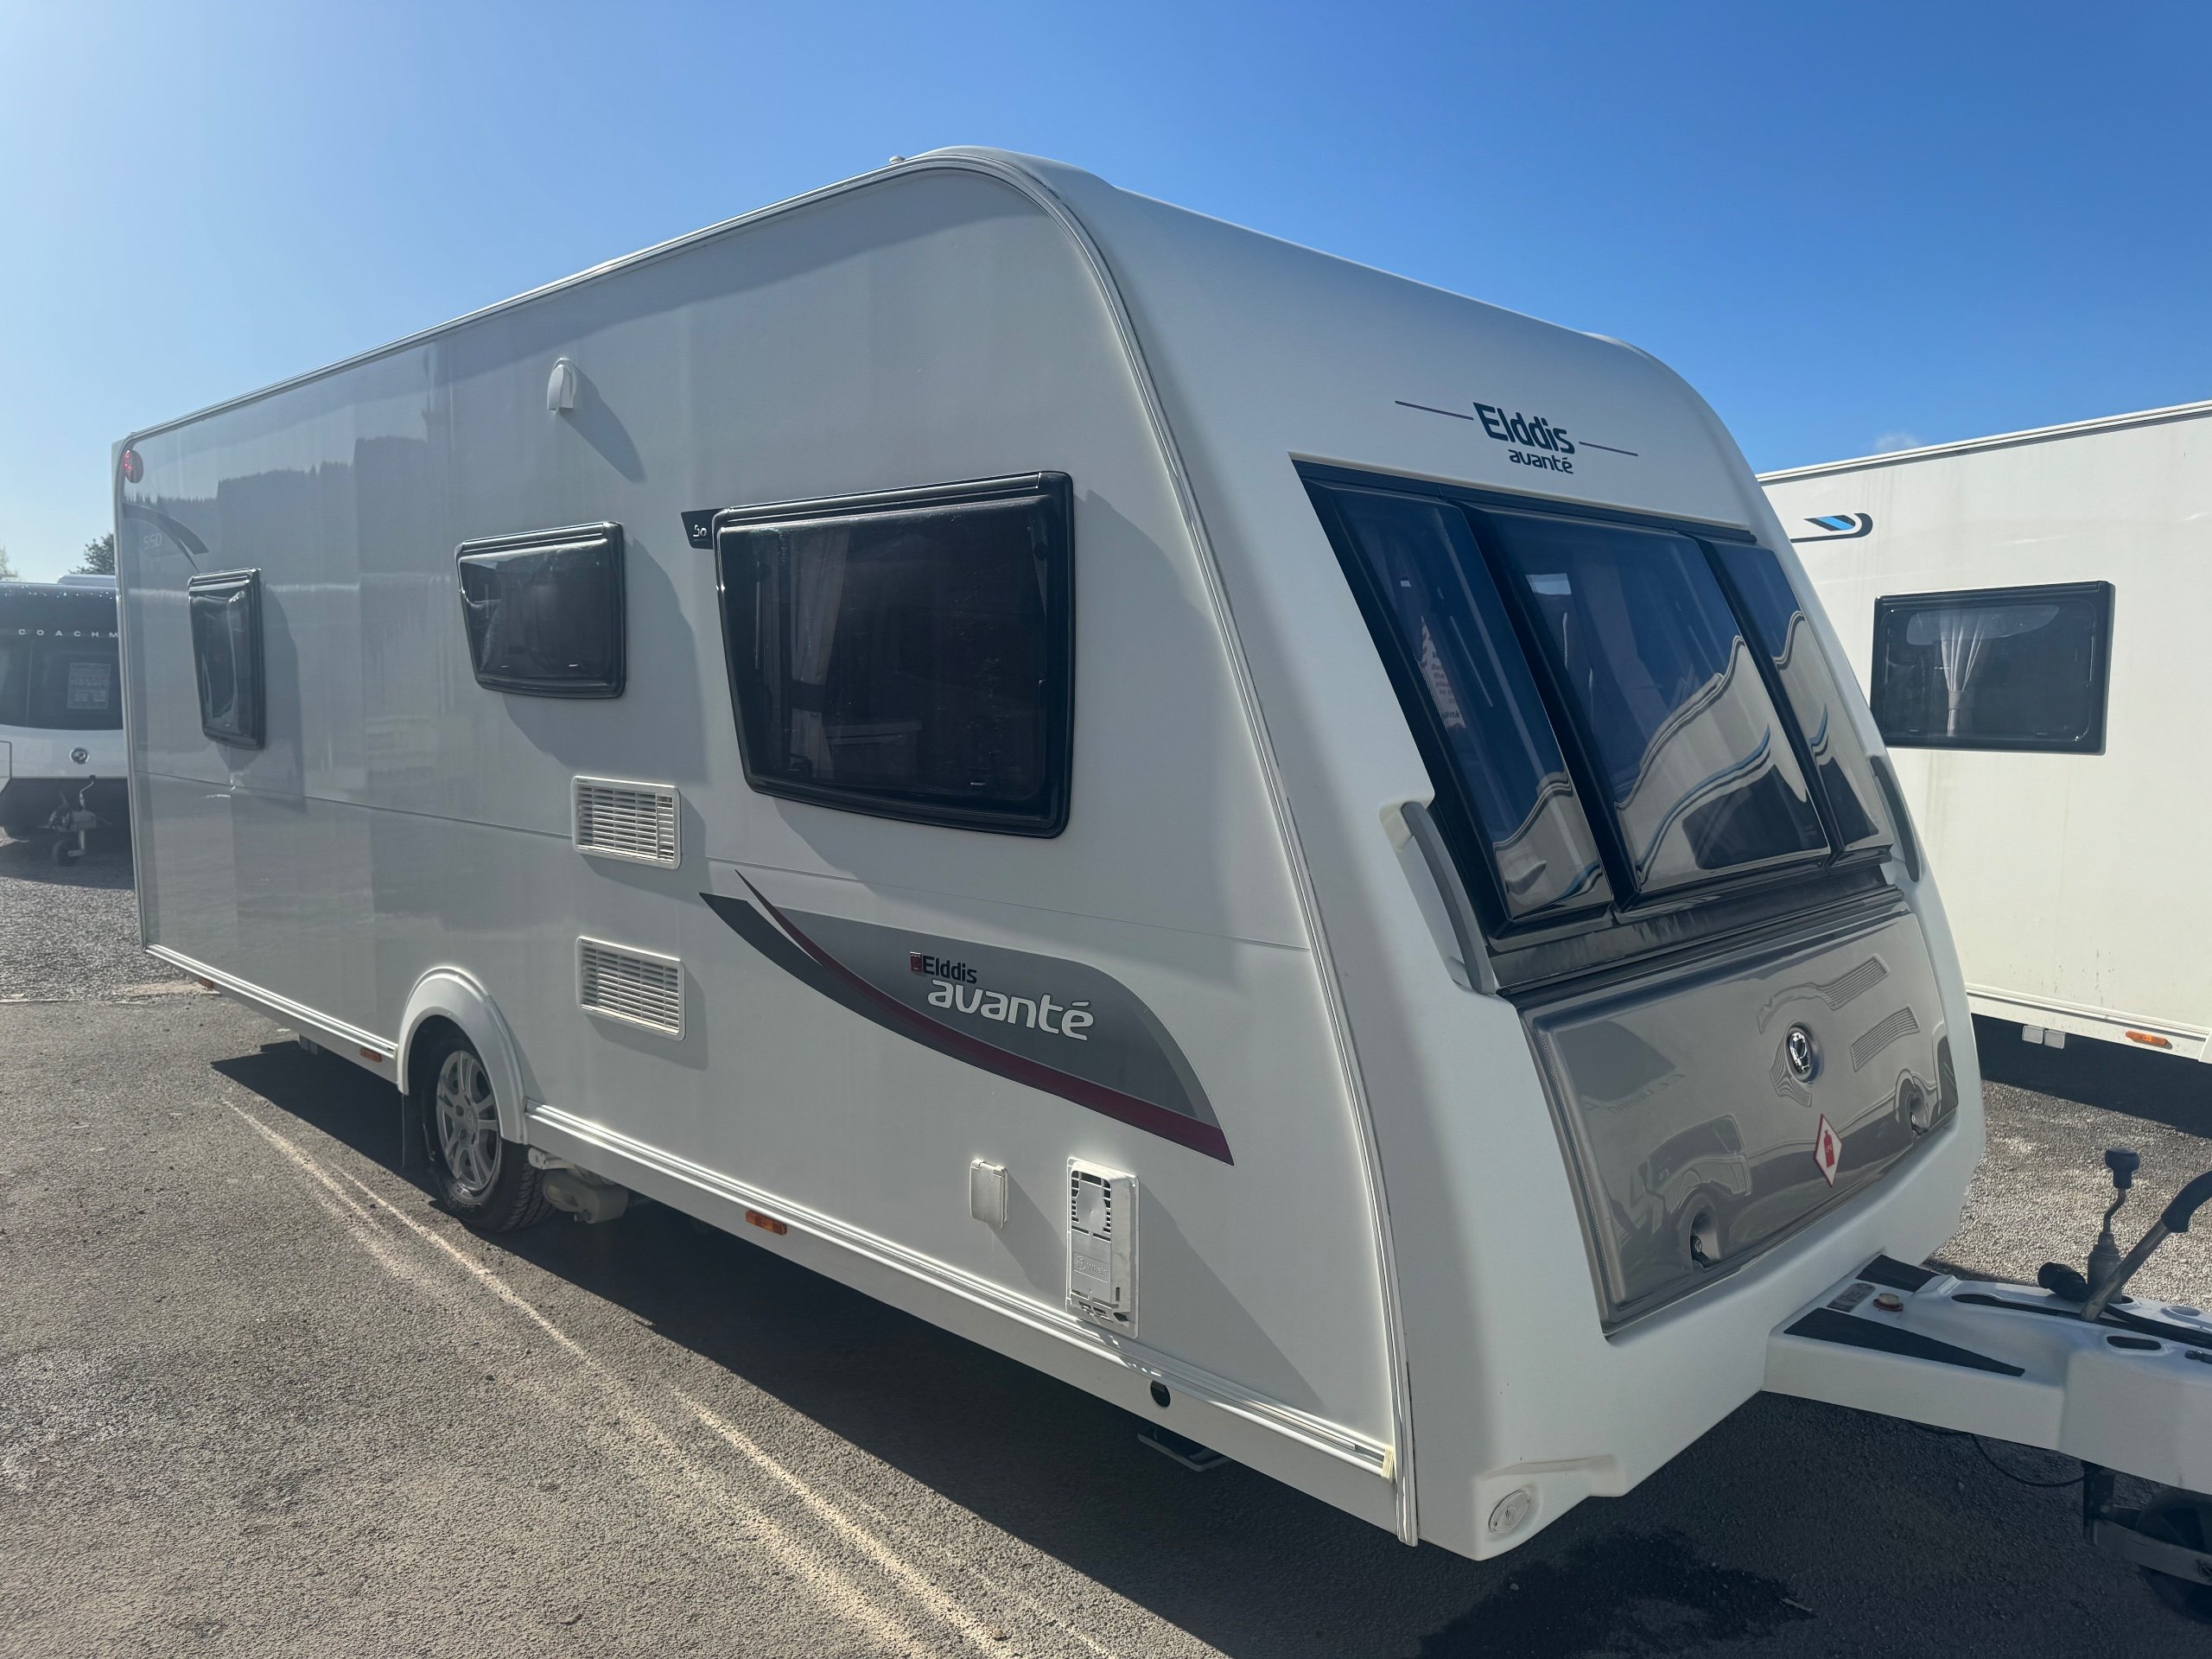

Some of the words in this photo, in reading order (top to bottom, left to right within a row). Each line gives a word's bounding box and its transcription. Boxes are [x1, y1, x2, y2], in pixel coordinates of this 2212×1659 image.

[1473, 402, 1575, 454] Elddis
[1508, 448, 1574, 474] avanté
[923, 955, 977, 984] Elddis
[927, 979, 1094, 1041] avanté
